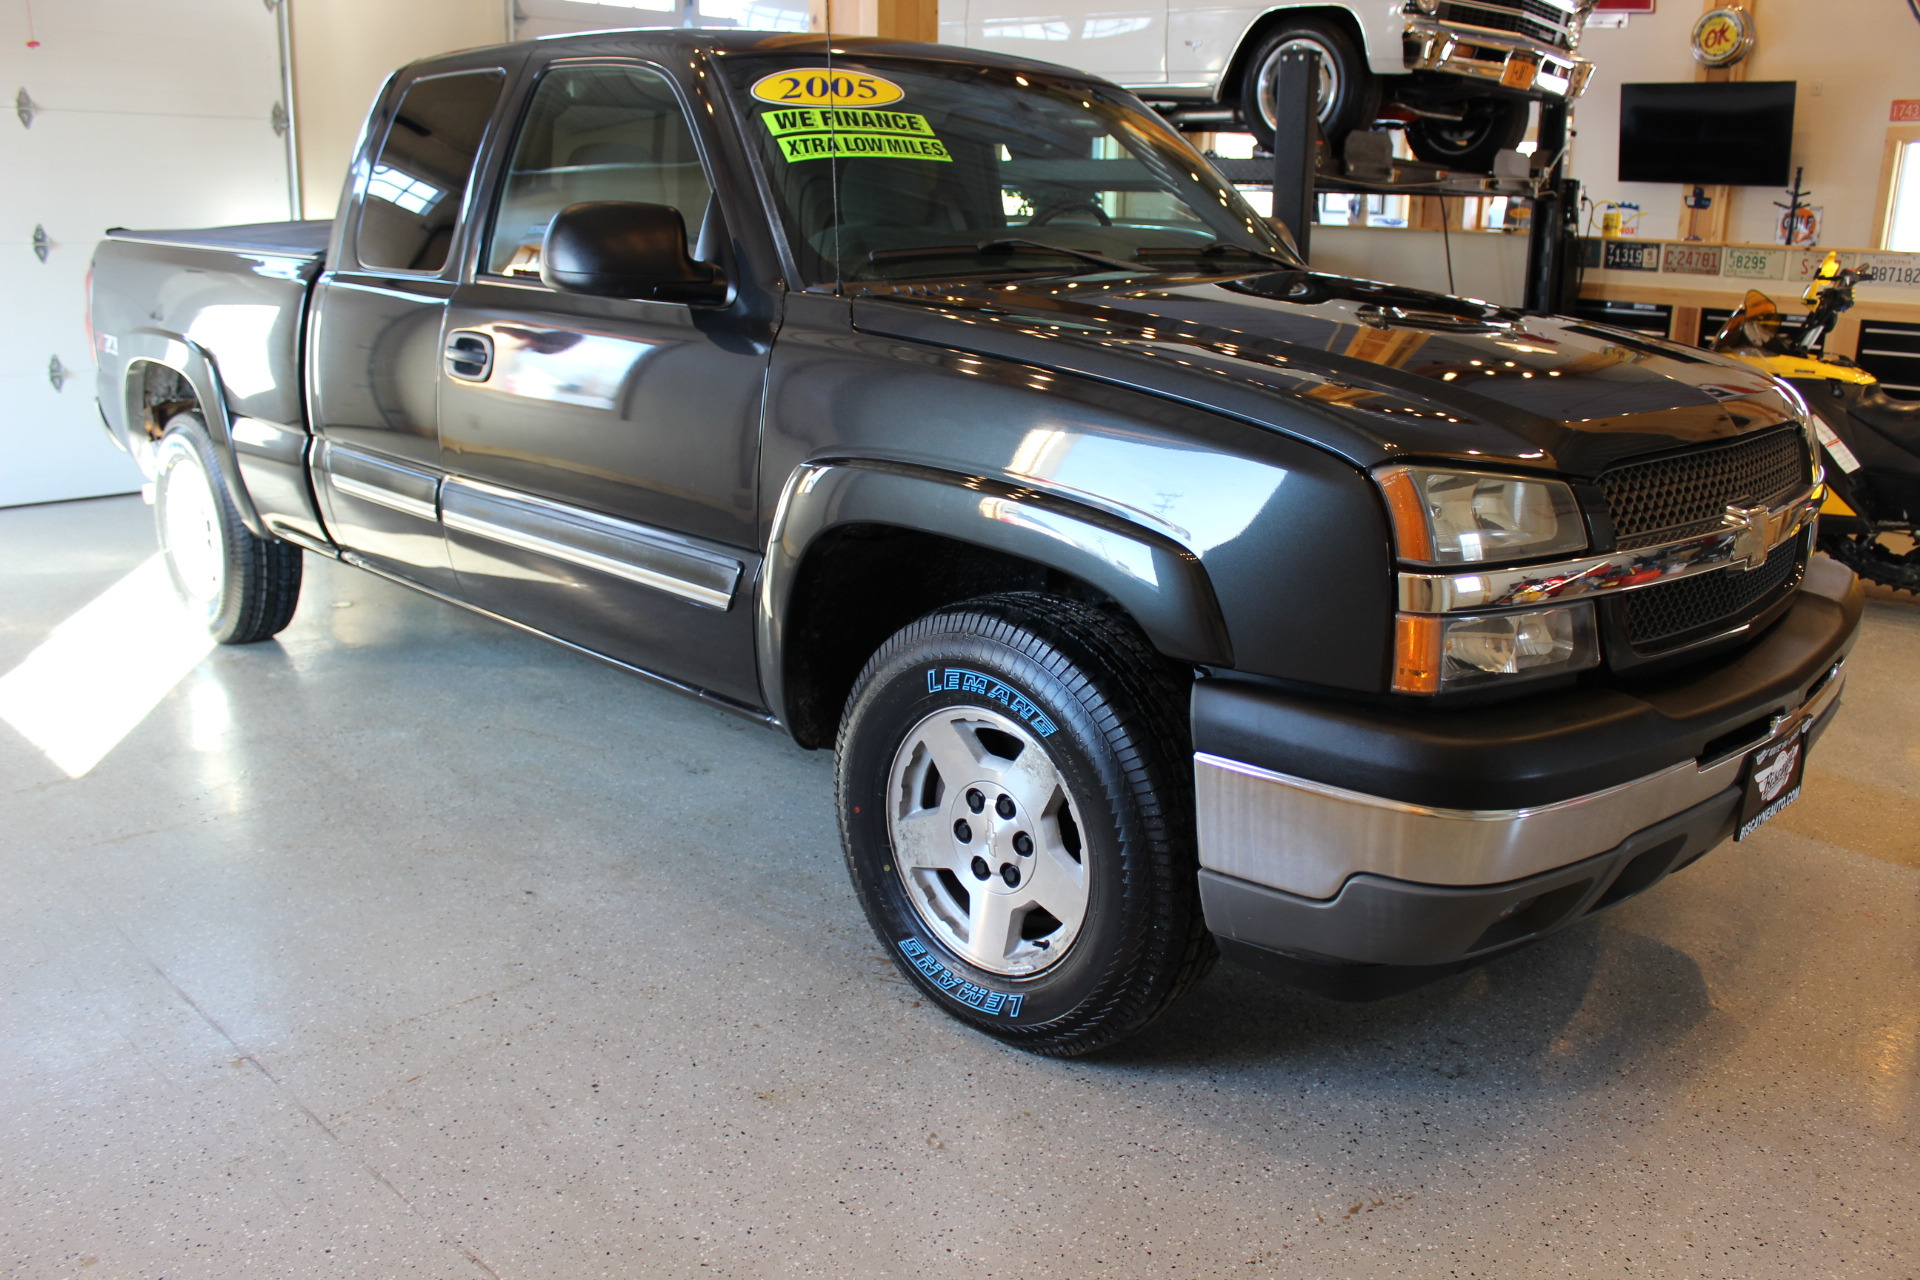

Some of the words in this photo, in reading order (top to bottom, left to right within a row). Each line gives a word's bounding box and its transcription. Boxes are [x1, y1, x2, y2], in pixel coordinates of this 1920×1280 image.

[1704, 22, 1731, 49] OK
[779, 76, 877, 99] 2005
[773, 111, 815, 130] WE
[822, 110, 923, 132] FINANCE
[789, 137, 841, 156] XTRA
[843, 137, 882, 152] LOW
[886, 139, 944, 156] MILES
[927, 667, 1059, 738] LEMANS
[1740, 786, 1801, 840] BISCAYNEAUTO.COM
[898, 936, 1025, 1018] LEMANS
